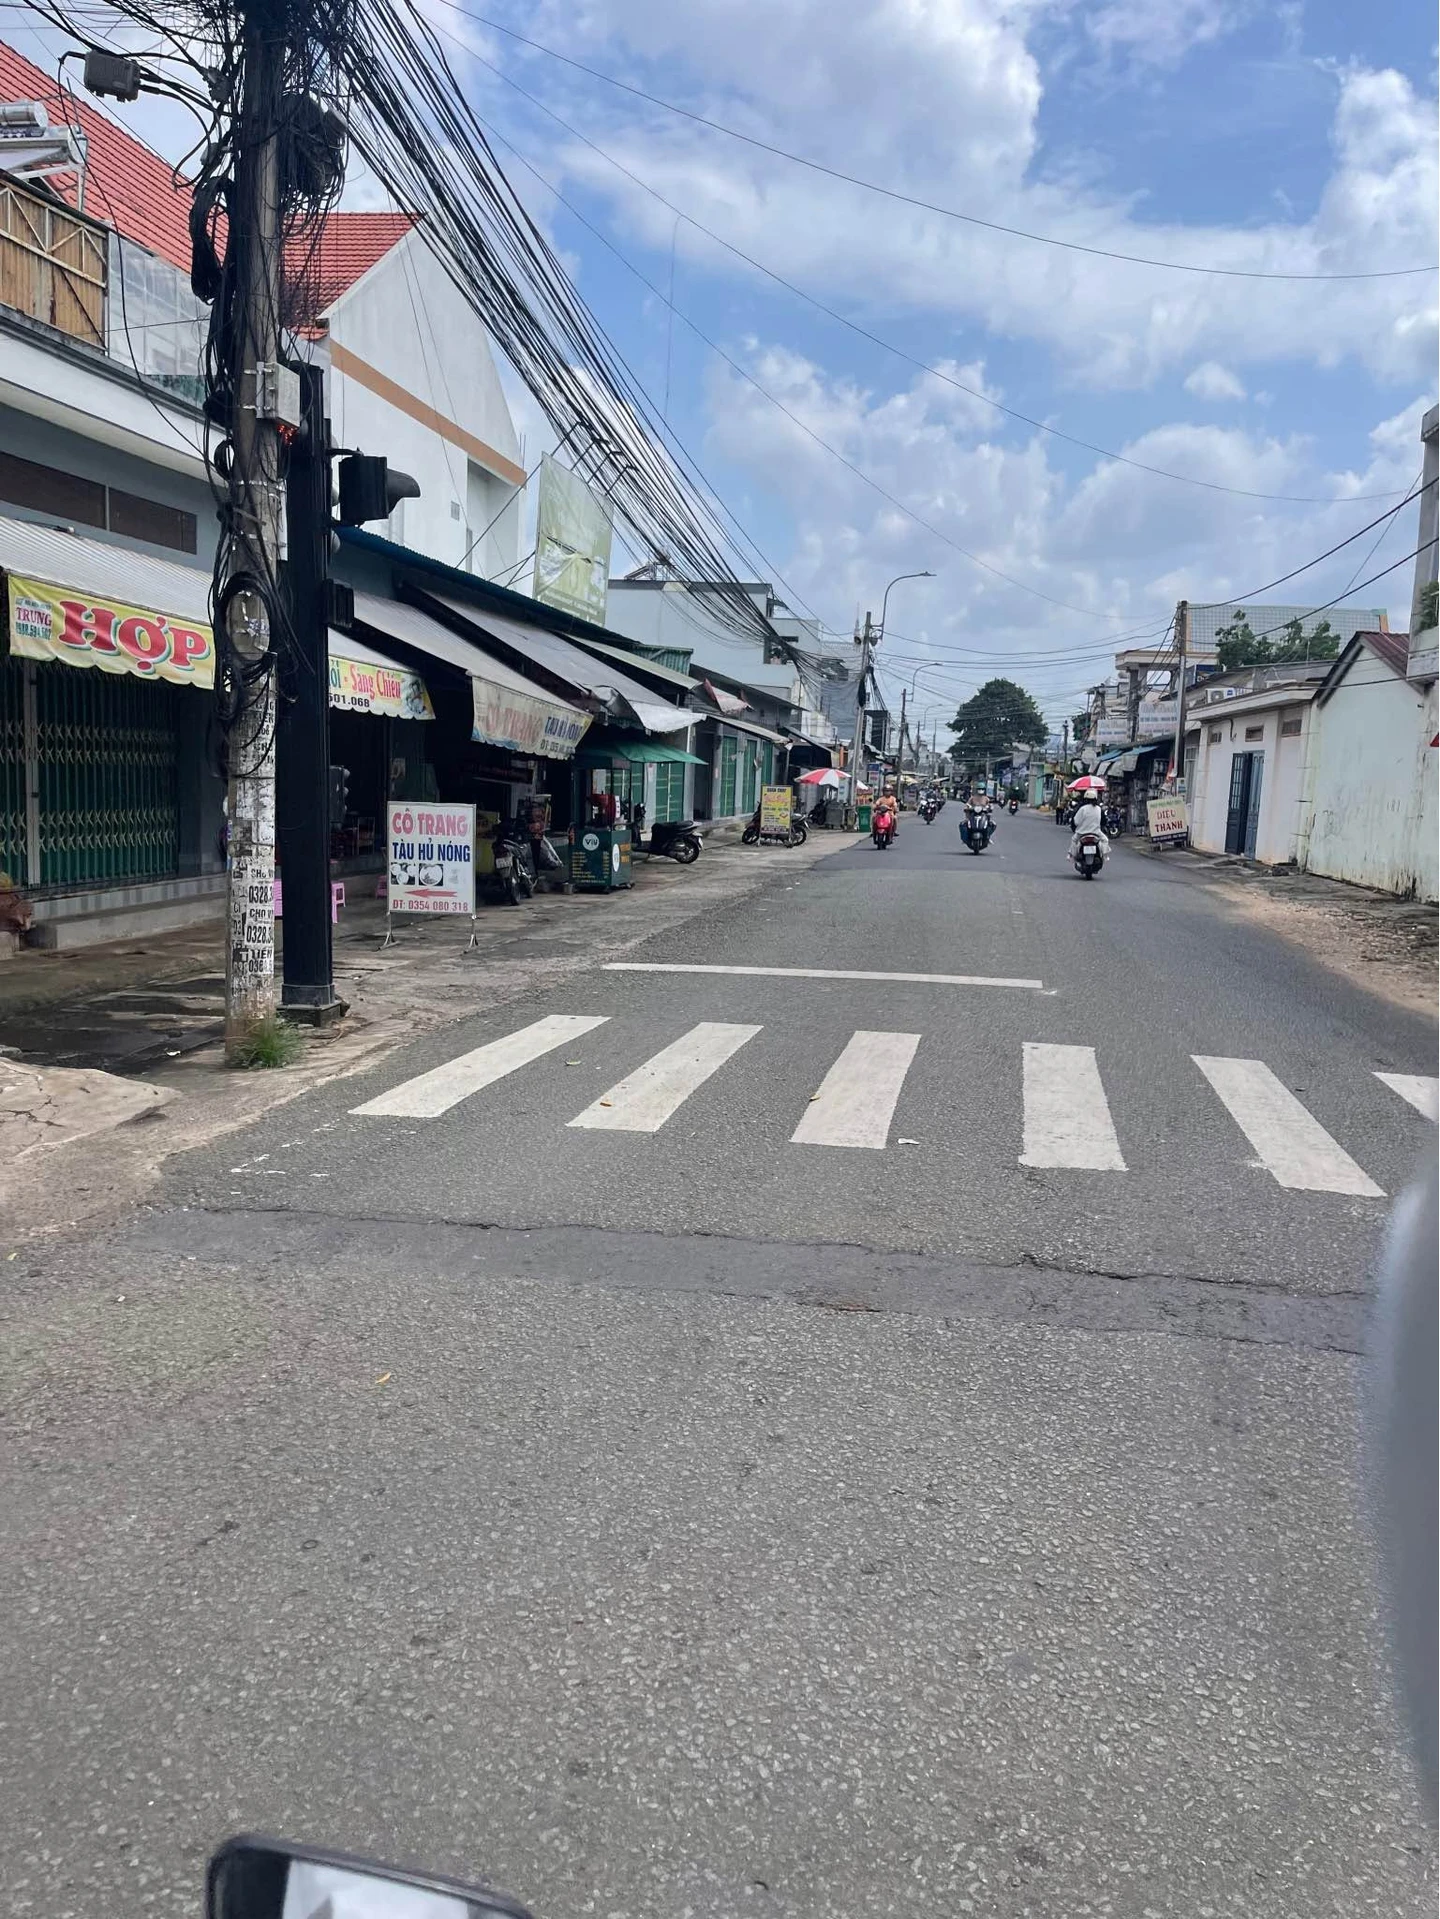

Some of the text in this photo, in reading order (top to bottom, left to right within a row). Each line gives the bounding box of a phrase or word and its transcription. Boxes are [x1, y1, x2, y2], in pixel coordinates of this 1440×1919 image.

[15, 606, 52, 626] TRUNG
[58, 600, 209, 673] HỢP
[392, 808, 469, 837] CÔ TRANG
[392, 838, 471, 862] TÀU HỦ NÓNG
[409, 901, 430, 910] 0354
[433, 902, 449, 911] 080
[452, 902, 468, 912] 318
